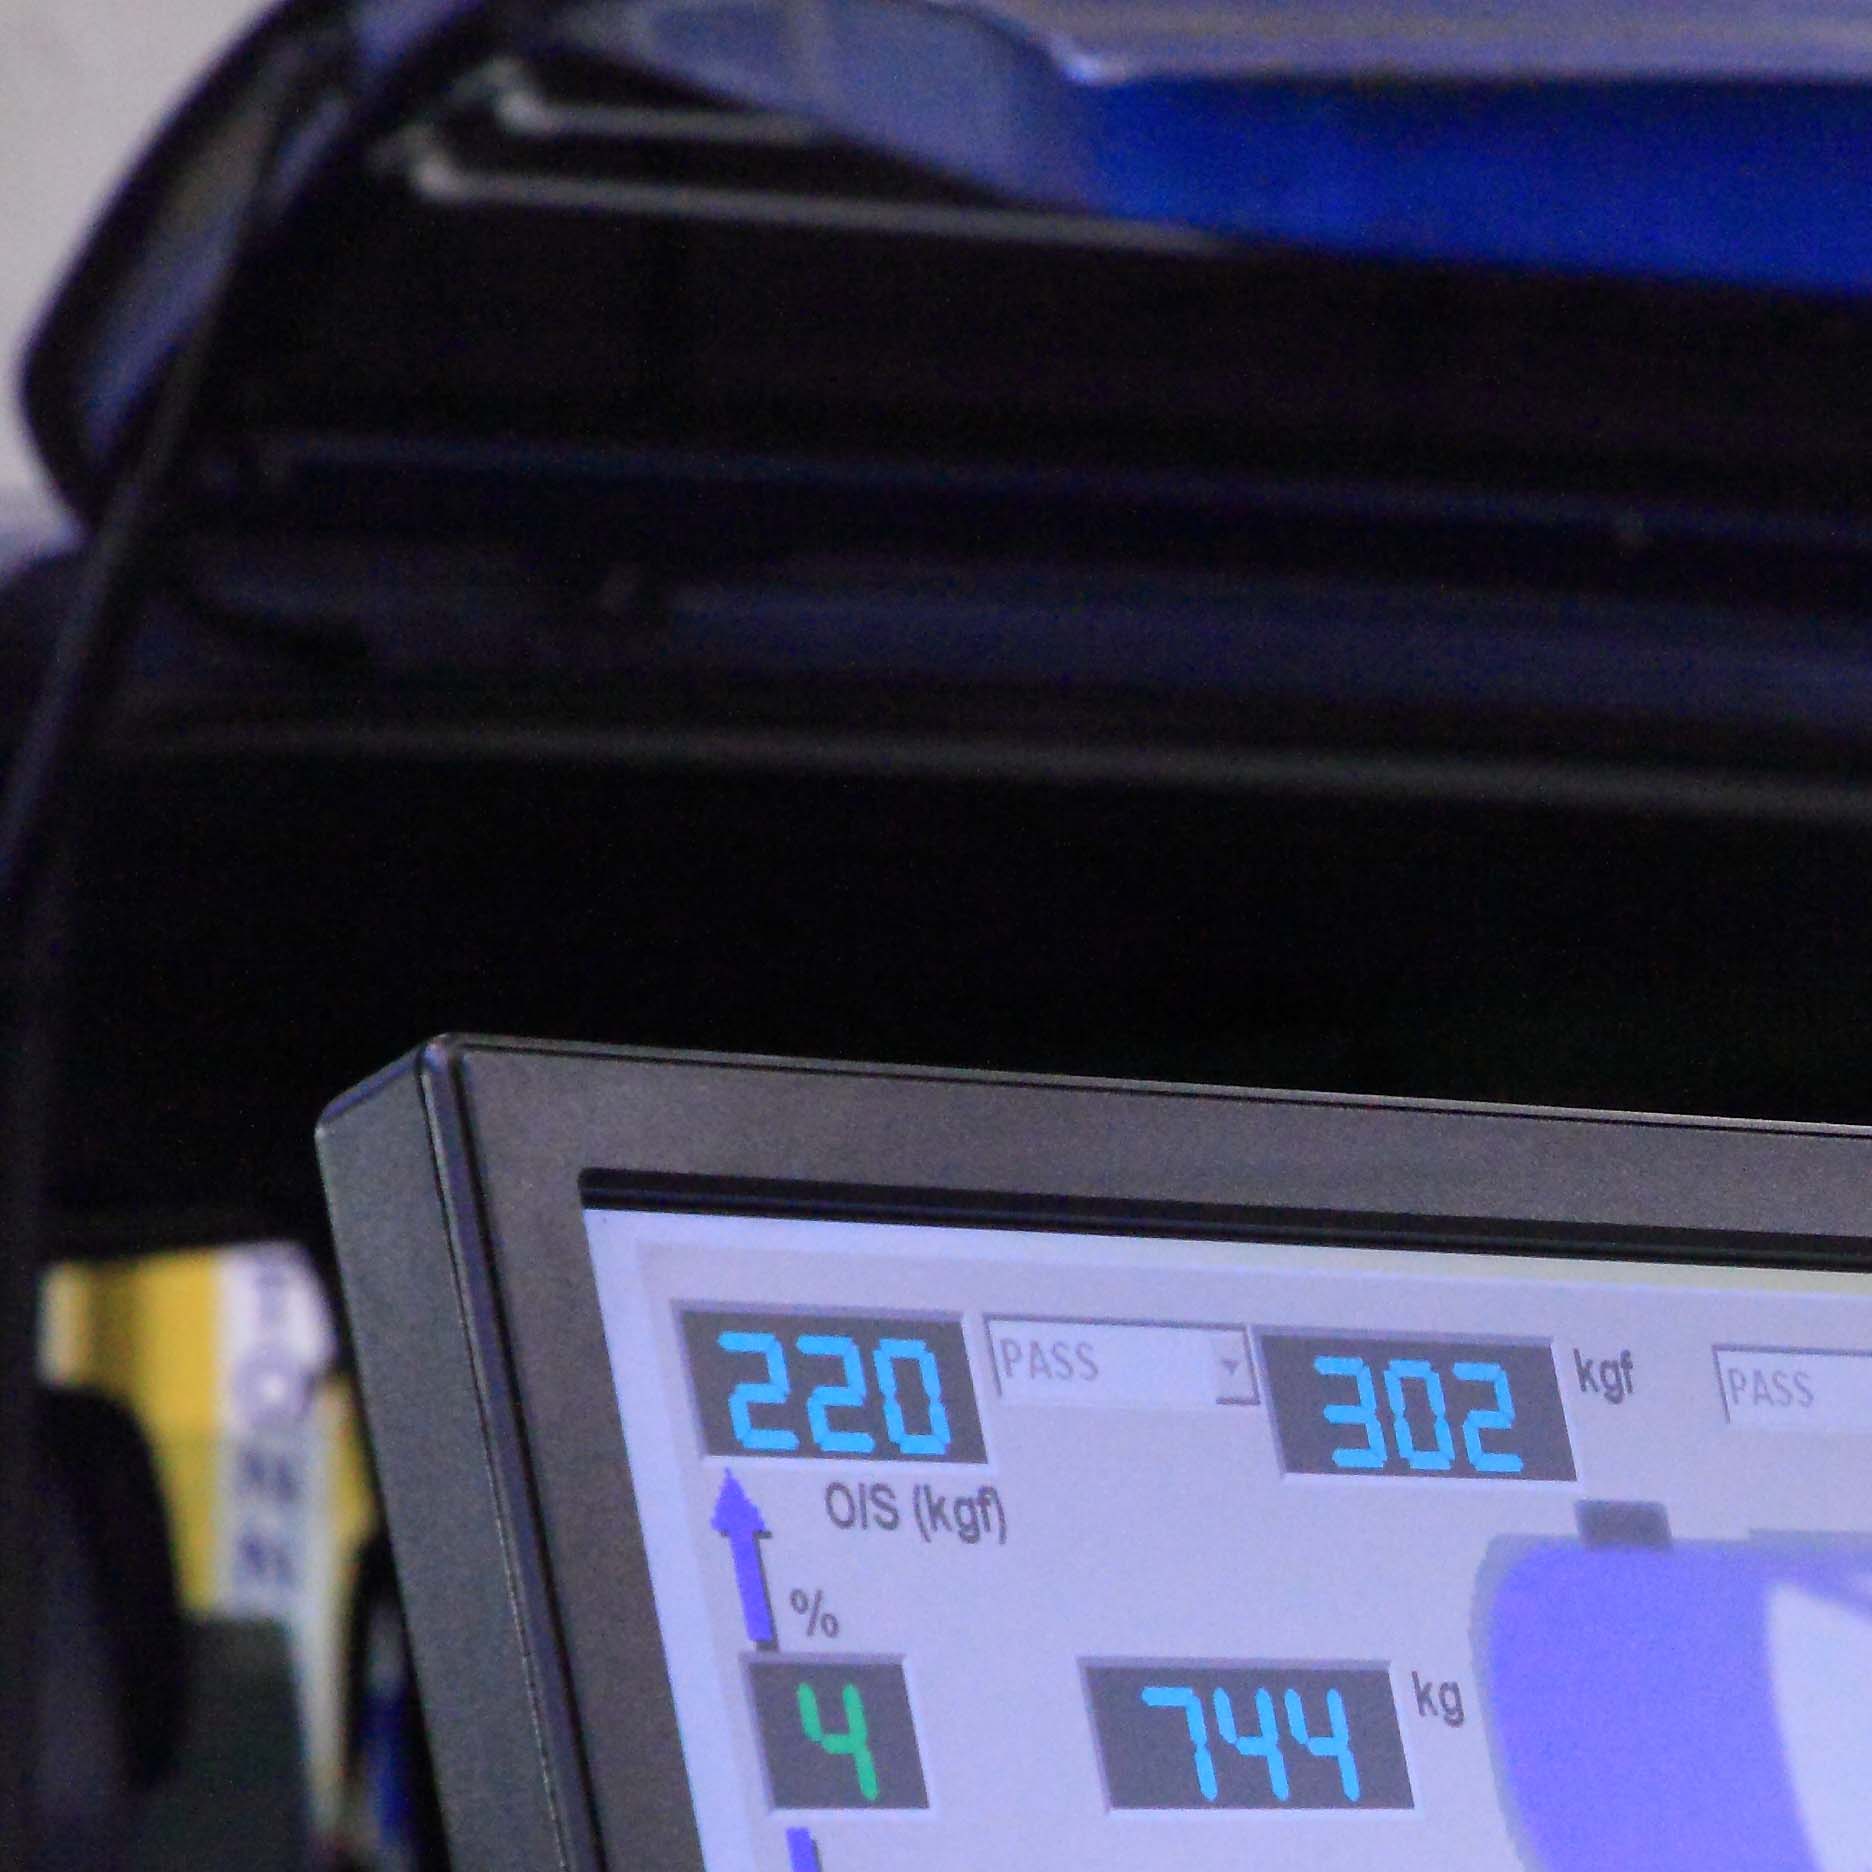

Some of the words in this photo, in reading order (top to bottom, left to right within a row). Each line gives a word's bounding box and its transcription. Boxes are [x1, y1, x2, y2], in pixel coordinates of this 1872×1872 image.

[717, 1331, 950, 1456] 220
[1000, 1337, 1099, 1383] PASS
[1727, 1366, 1814, 1408] PASS
[1315, 1356, 1524, 1472] 302
[1573, 1348, 1636, 1403] kgf
[912, 1485, 1007, 1544] (kgf)
[790, 1588, 839, 1638] %
[797, 1682, 878, 1800] 4
[1140, 1686, 1360, 1802] 744
[1413, 1672, 1464, 1726] kg
